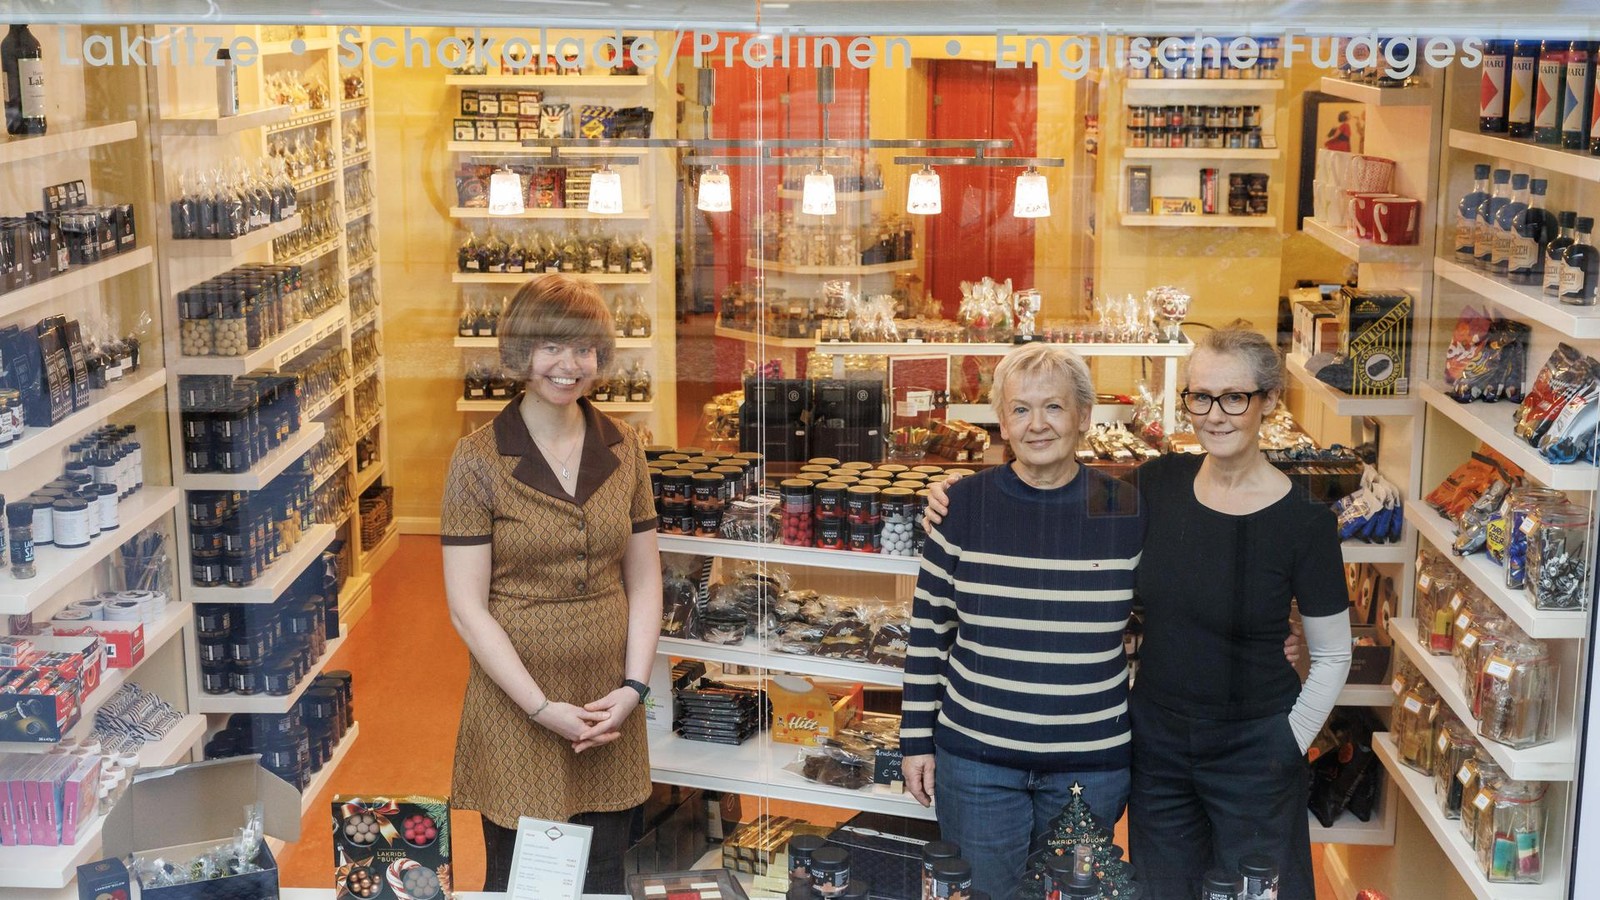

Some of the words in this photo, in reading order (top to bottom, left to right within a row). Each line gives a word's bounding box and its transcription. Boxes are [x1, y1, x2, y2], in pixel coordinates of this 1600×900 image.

[59, 26, 259, 67] Lakritze
[338, 26, 912, 77] Schokolade/Pralinen
[995, 28, 1260, 80] Englische
[1284, 28, 1482, 80] Fudges
[1351, 302, 1409, 354] PATRONER
[1362, 347, 1396, 360] ORIGINAL
